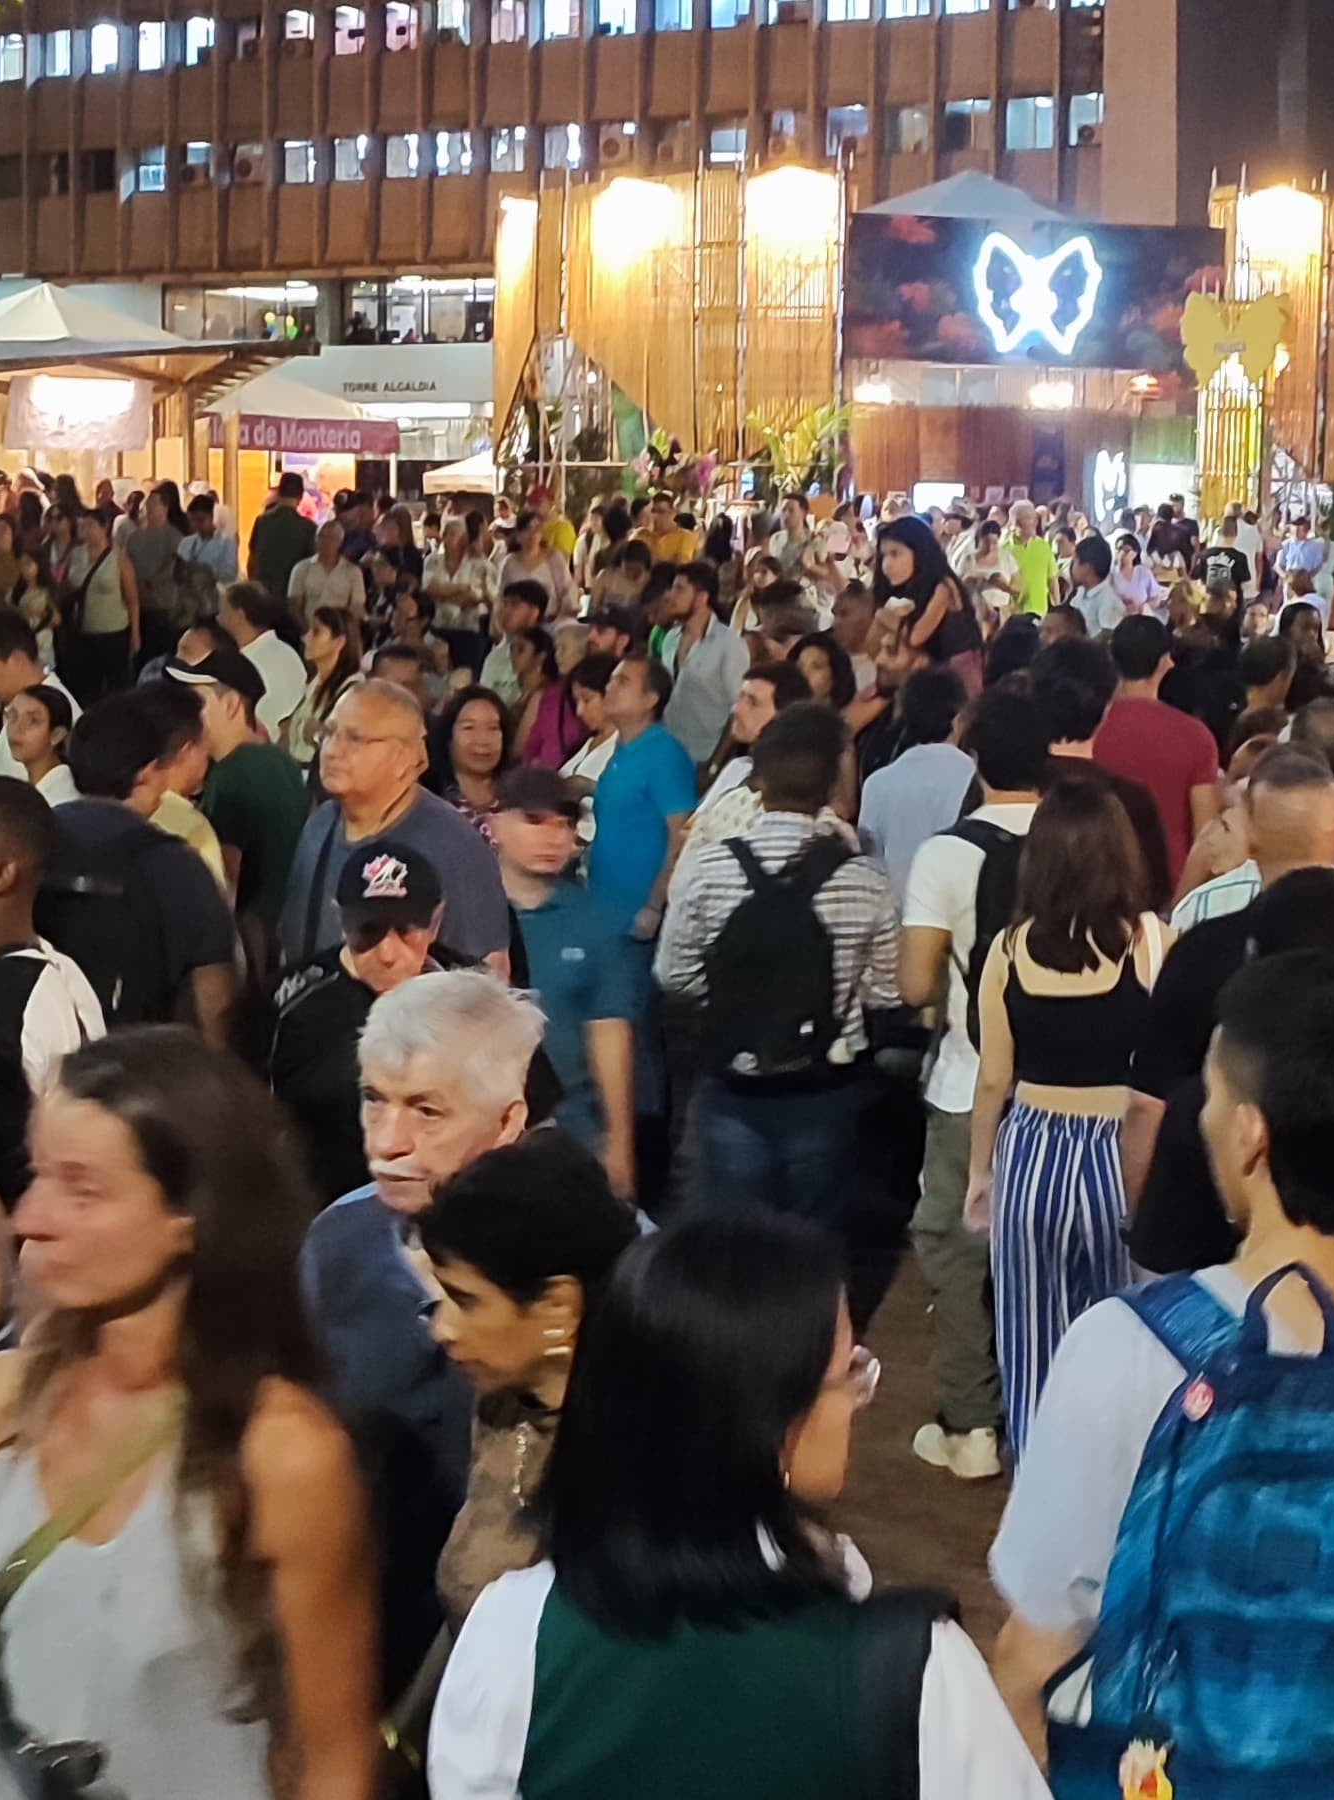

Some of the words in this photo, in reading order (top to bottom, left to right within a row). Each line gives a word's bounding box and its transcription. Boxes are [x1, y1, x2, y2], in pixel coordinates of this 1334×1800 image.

[343, 382, 378, 393] TORRE
[253, 418, 277, 446] de
[280, 421, 361, 450] Montería
